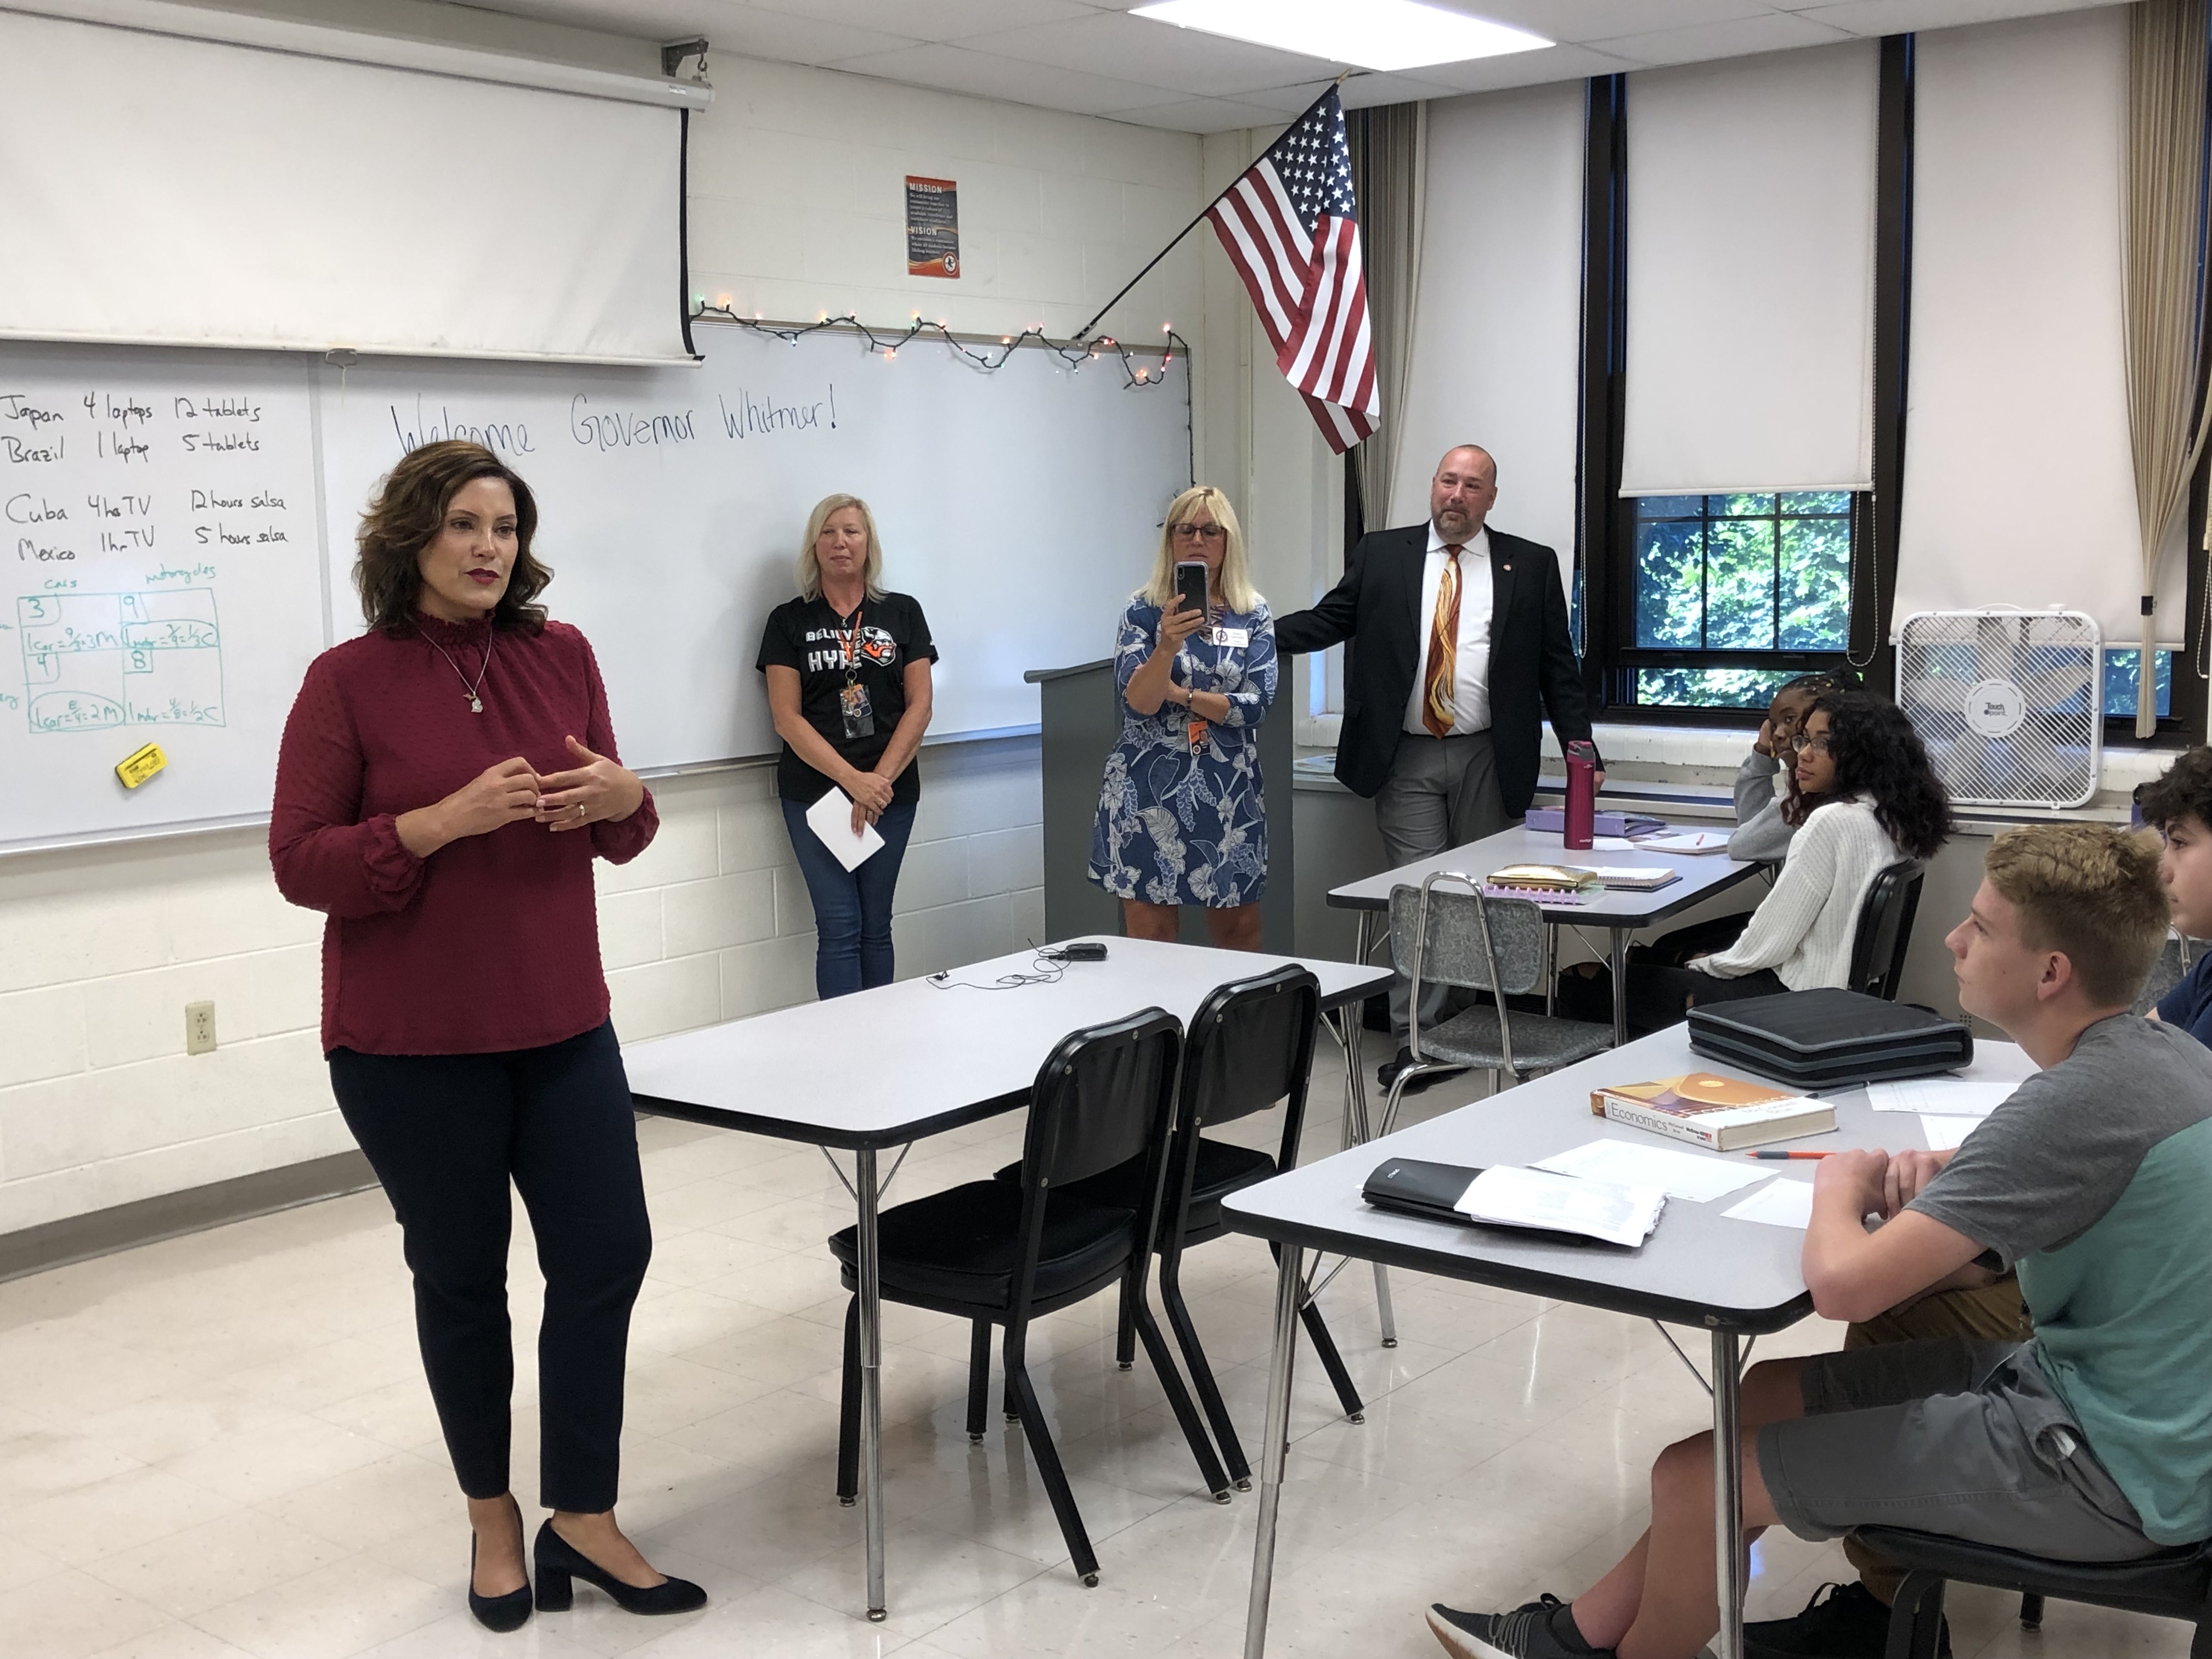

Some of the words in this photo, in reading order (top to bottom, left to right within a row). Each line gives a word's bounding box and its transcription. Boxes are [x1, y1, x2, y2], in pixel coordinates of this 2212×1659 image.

[910, 183, 942, 194] MISSION
[911, 226, 937, 235] VISION
[0, 394, 64, 430] Japan
[83, 391, 96, 419] 4
[106, 394, 153, 430] laptops
[174, 397, 198, 419] 12
[202, 396, 261, 422] tablets
[571, 393, 695, 452] Governor
[719, 383, 837, 439] Whitmer!
[0, 436, 64, 463] Brazil
[98, 431, 103, 458] 1
[113, 431, 149, 463] laptop
[182, 434, 200, 452] 5
[202, 432, 259, 452] tablets
[5, 493, 69, 523] Cuba
[122, 495, 151, 516] TV
[251, 490, 287, 510] salsa
[18, 538, 76, 561] Mexico
[124, 525, 154, 548] TV
[195, 526, 212, 544] 5
[219, 522, 251, 545] hours
[256, 524, 289, 543] salsa
[27, 595, 45, 618] 3
[123, 595, 138, 619] 9
[131, 650, 146, 669] 8
[808, 648, 862, 673] HYPE
[1985, 702, 2005, 710] Touch
[1611, 1102, 1668, 1131] Economics
